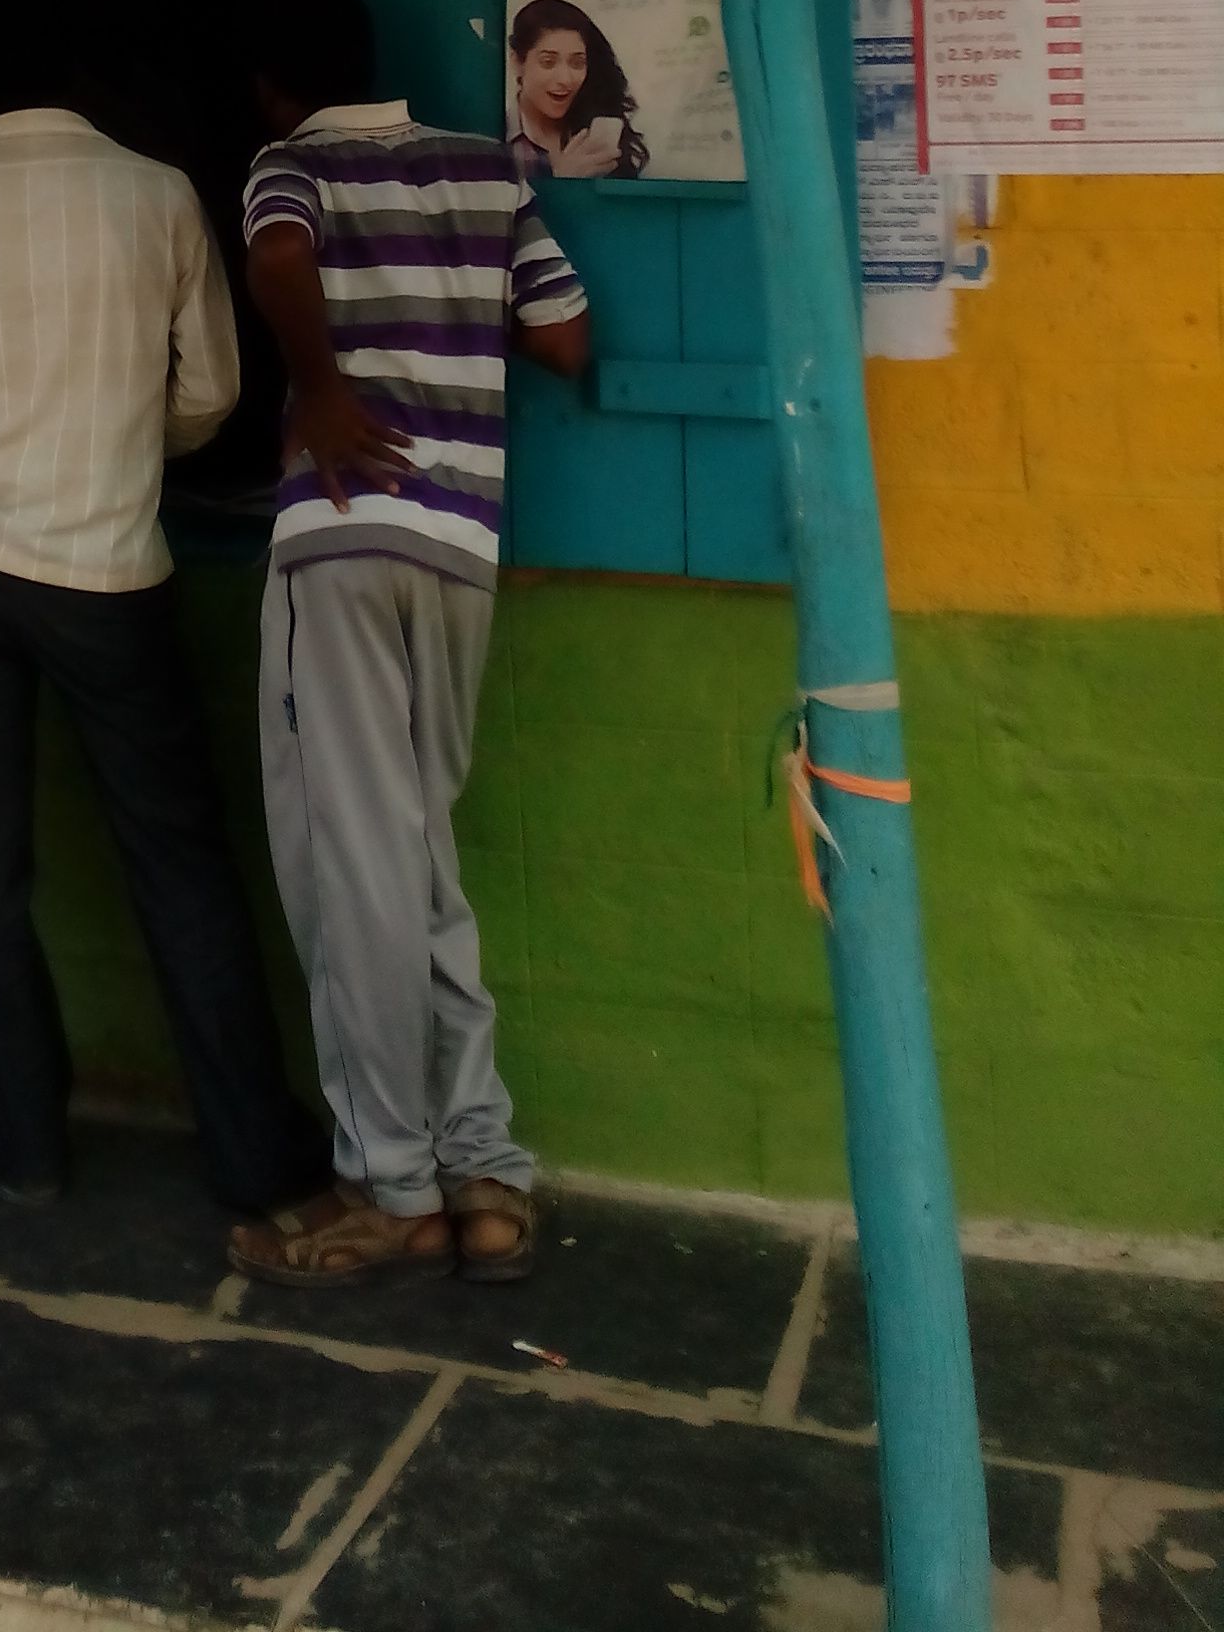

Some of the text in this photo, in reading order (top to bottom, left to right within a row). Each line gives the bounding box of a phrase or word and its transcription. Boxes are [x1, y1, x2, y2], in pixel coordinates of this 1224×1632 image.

[947, 6, 1007, 24] 1p/sec
[947, 46, 1023, 63] 2.5p/sec
[936, 74, 958, 88] 97
